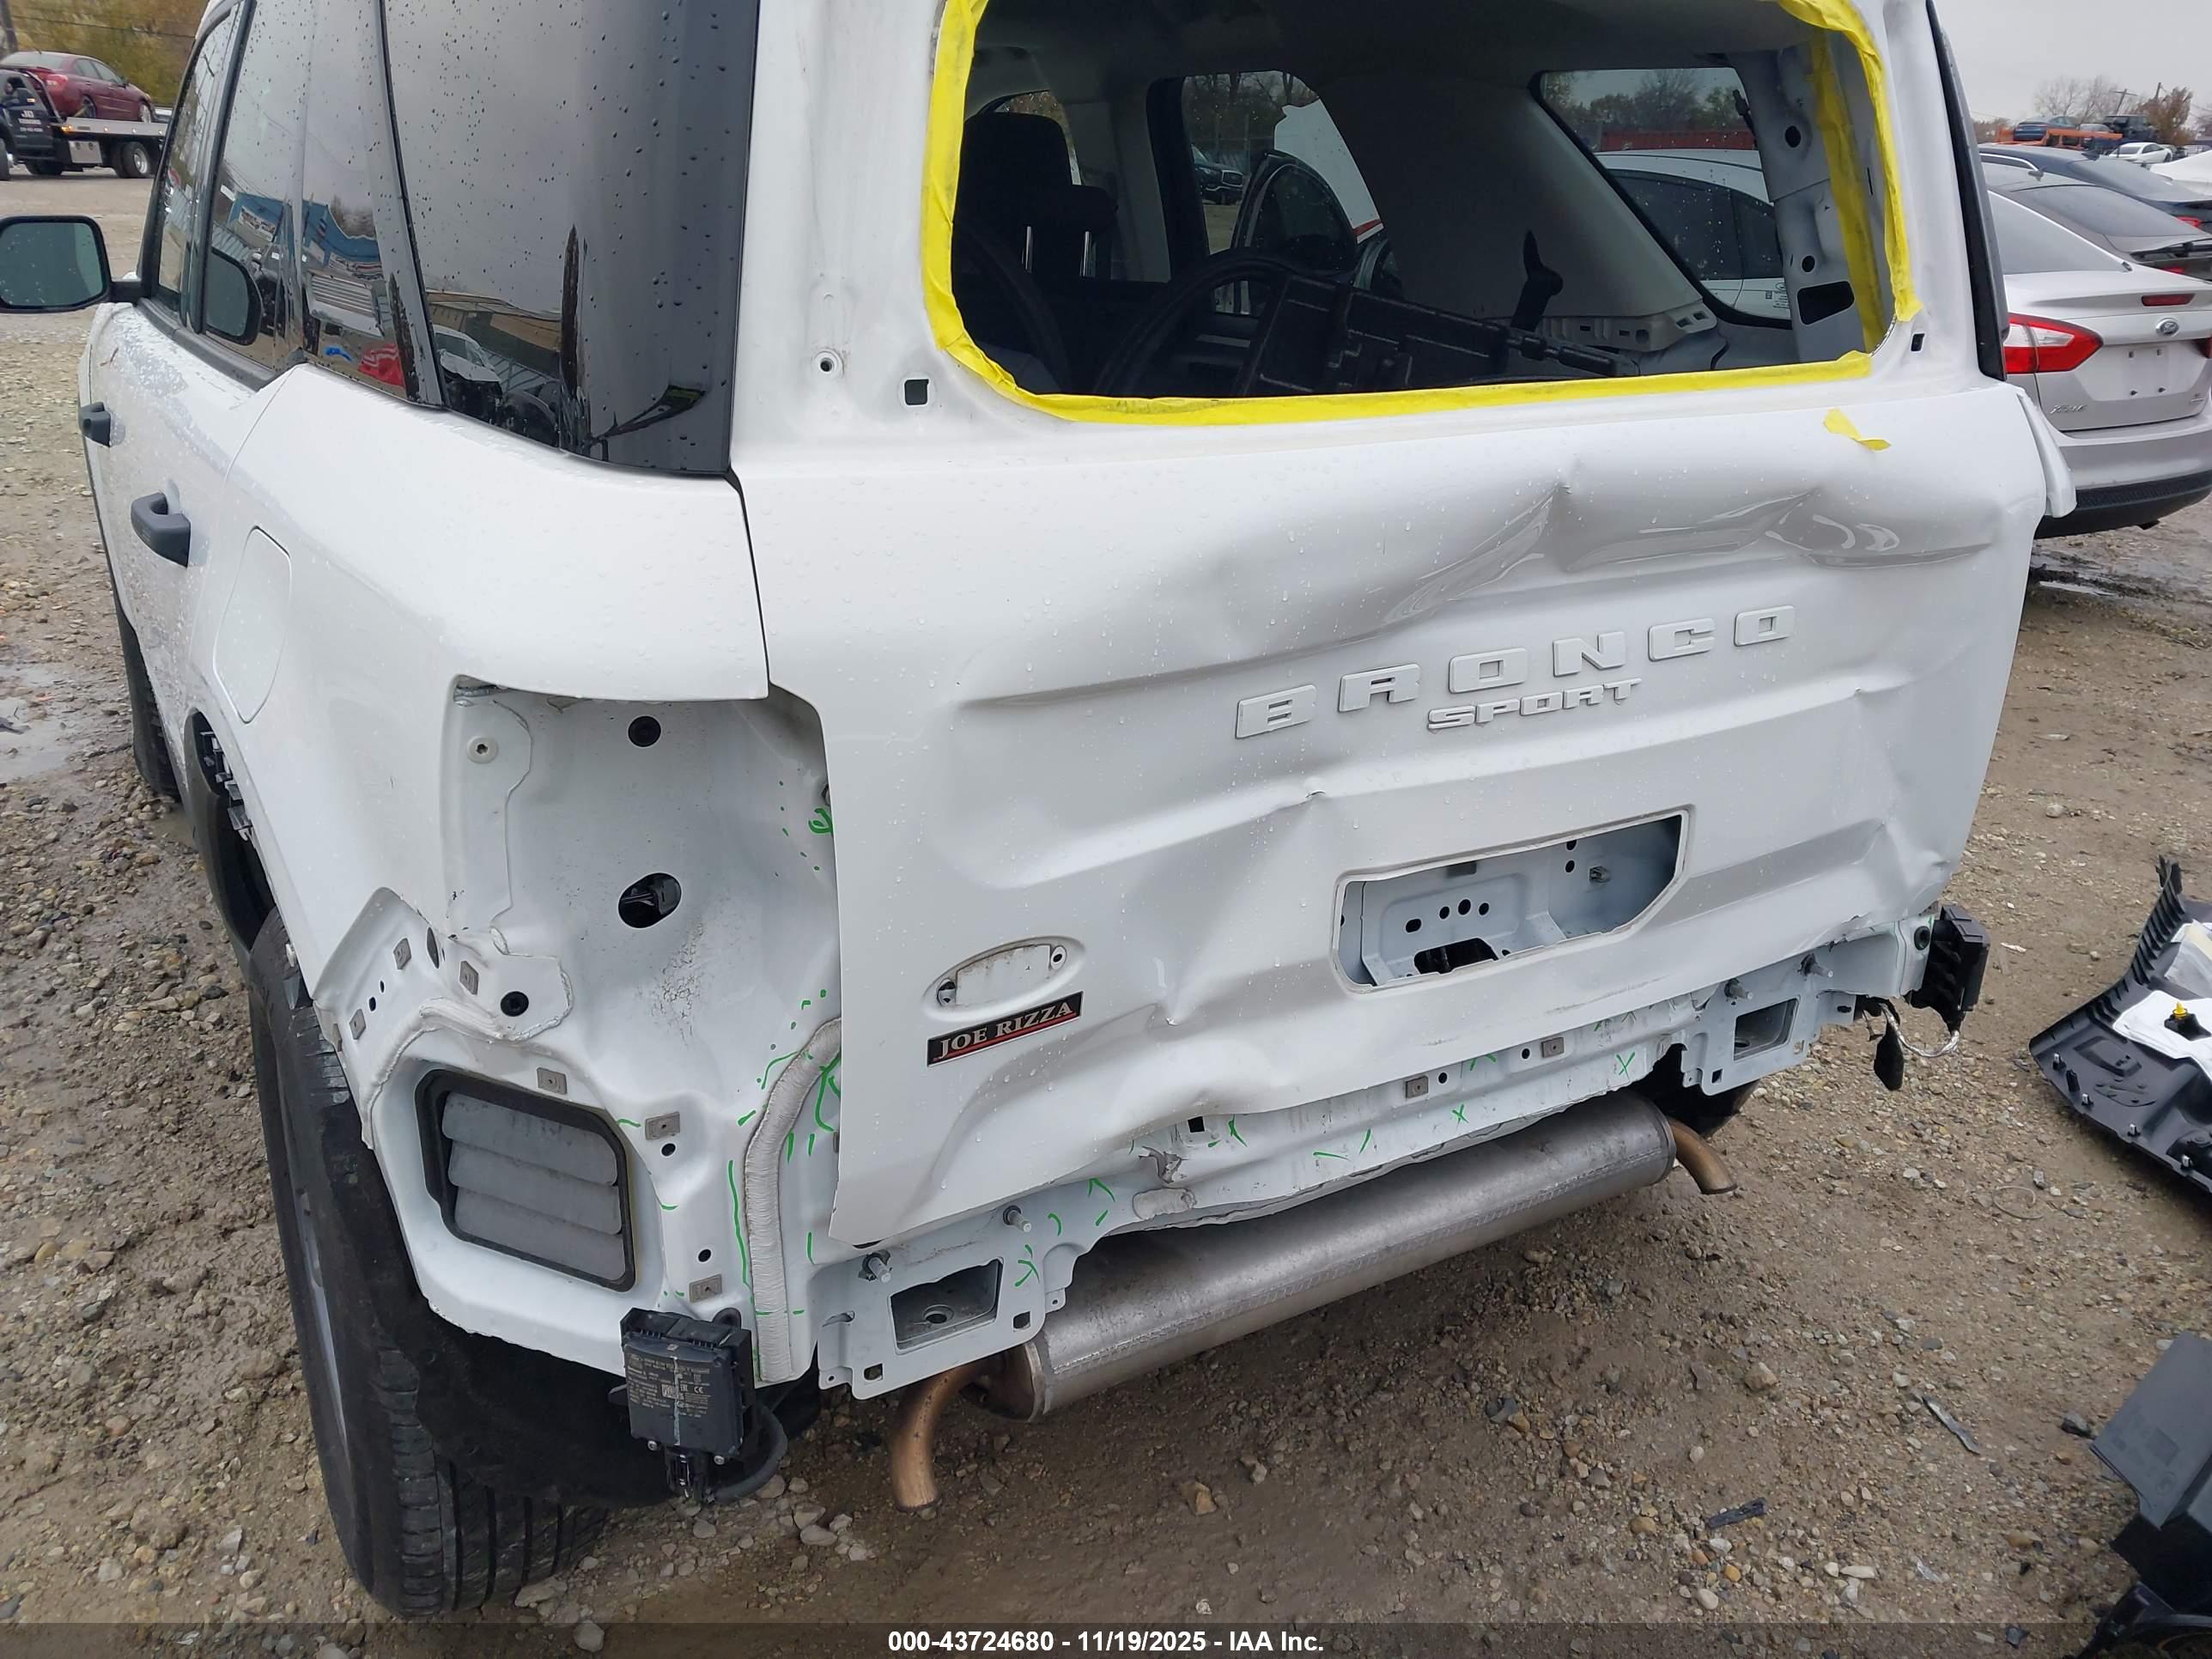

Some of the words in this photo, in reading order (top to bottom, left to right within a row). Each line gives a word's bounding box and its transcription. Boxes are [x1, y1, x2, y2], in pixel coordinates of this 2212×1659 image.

[1236, 605, 1795, 738] BRONCO
[1427, 678, 1642, 731] SPORT
[939, 1028, 988, 1059] JOE
[995, 1001, 1073, 1037] RIZZA
